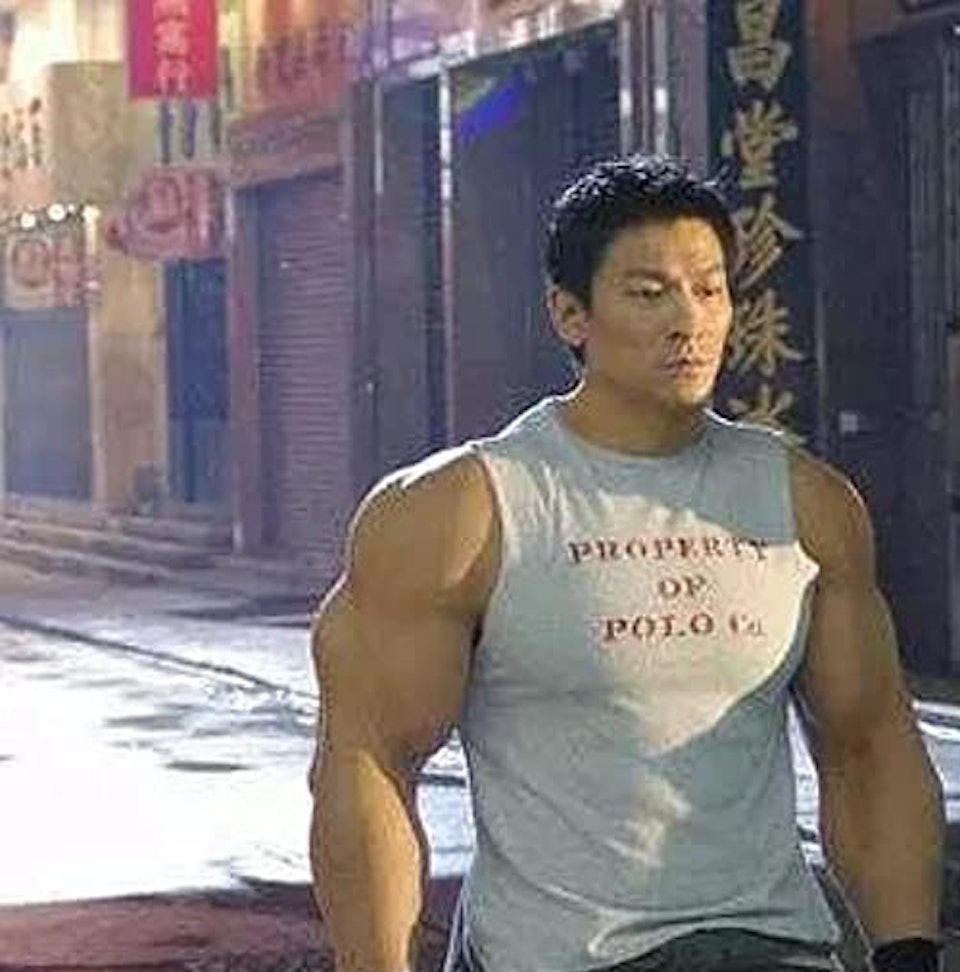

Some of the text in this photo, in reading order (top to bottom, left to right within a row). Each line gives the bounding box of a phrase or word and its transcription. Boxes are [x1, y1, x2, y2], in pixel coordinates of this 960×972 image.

[568, 536, 768, 564] PROPERTY
[659, 574, 707, 600] OF
[603, 612, 714, 642] POLO
